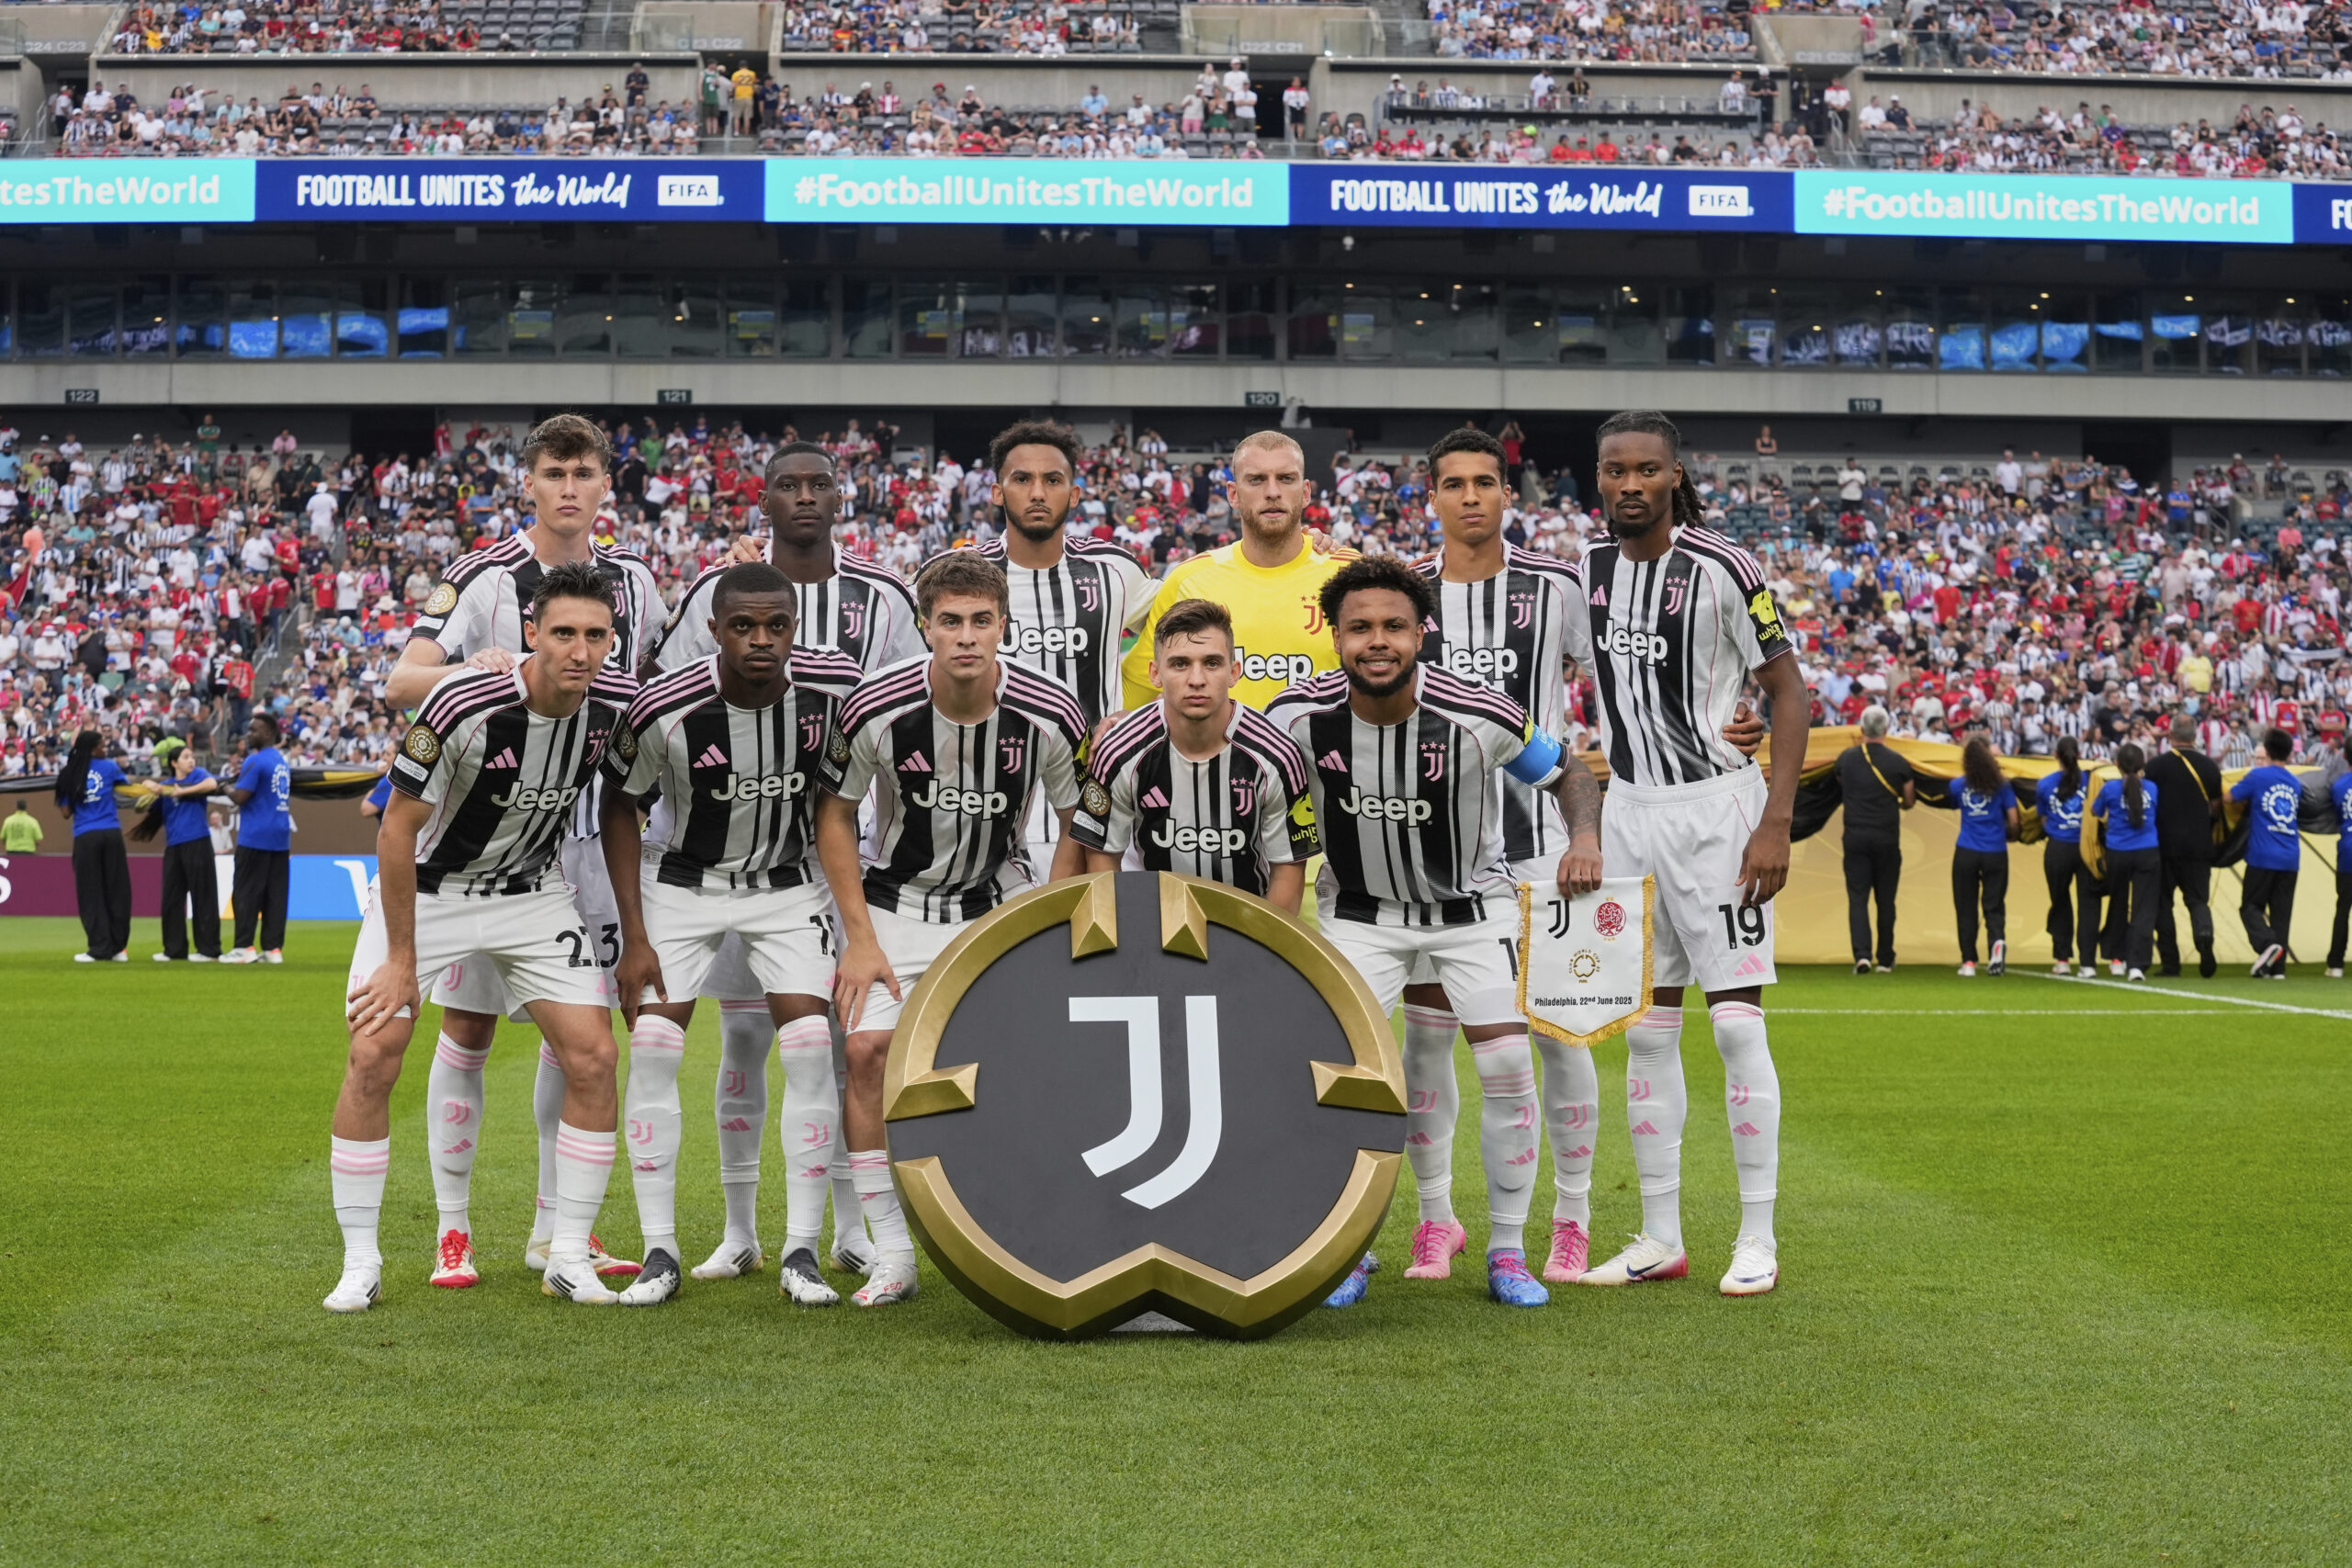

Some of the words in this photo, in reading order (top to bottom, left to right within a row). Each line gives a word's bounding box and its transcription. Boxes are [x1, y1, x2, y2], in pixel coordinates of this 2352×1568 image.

[297, 175, 415, 206] FOOTBALL
[420, 175, 505, 206] UNITES
[511, 173, 555, 206] the
[556, 172, 631, 209] World
[668, 184, 707, 197] FIFA
[795, 174, 1252, 207] #FootballUnitesTheWorld
[1331, 180, 1450, 211] FOOTBALL
[1454, 182, 1538, 213] UNITES
[1544, 182, 1588, 214] the
[1589, 181, 1662, 217] World
[1700, 194, 1738, 208] FIFA
[1823, 186, 2259, 224] #FootballUnitesTheWorld
[70, 391, 96, 401] 122
[665, 391, 686, 402] 121
[1250, 394, 1276, 404] 120
[997, 620, 1088, 658] Jeep
[1597, 618, 1668, 667] Jeep
[1428, 641, 1519, 680] Jeep
[491, 780, 579, 814] Jeep
[711, 773, 805, 801] Jeep
[912, 779, 1008, 820] Jeep
[1339, 785, 1432, 828] Jeep
[1151, 818, 1246, 858] Jeep
[1718, 901, 1766, 950] 19
[1498, 937, 1521, 981] 1
[1598, 996, 1613, 1005] June
[1614, 996, 1633, 1005] 2025
